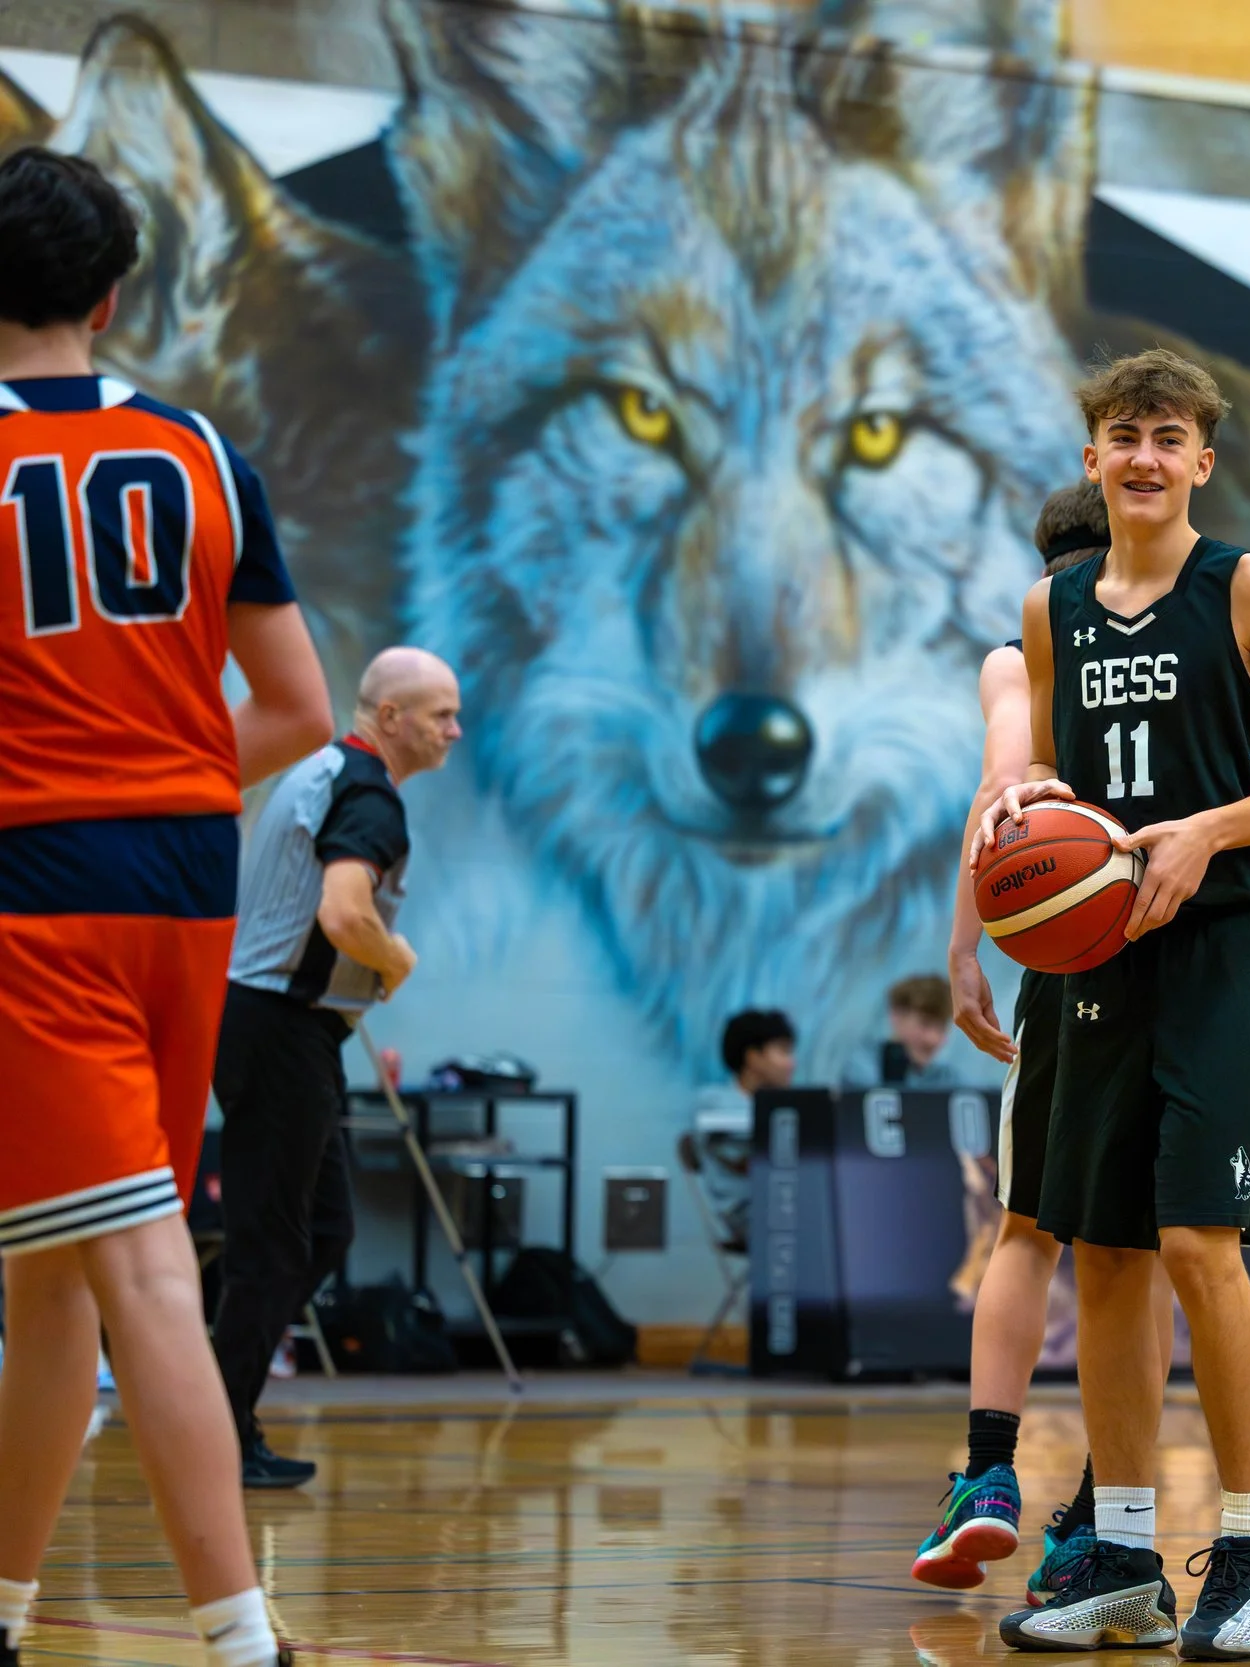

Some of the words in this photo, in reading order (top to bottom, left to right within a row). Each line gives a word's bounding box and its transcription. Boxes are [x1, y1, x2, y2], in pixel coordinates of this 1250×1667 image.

[0, 447, 196, 639] 10
[1081, 653, 1179, 709] GESS
[1103, 720, 1155, 800] 11
[998, 824, 1030, 850] FIBA
[990, 856, 1057, 898] molten
